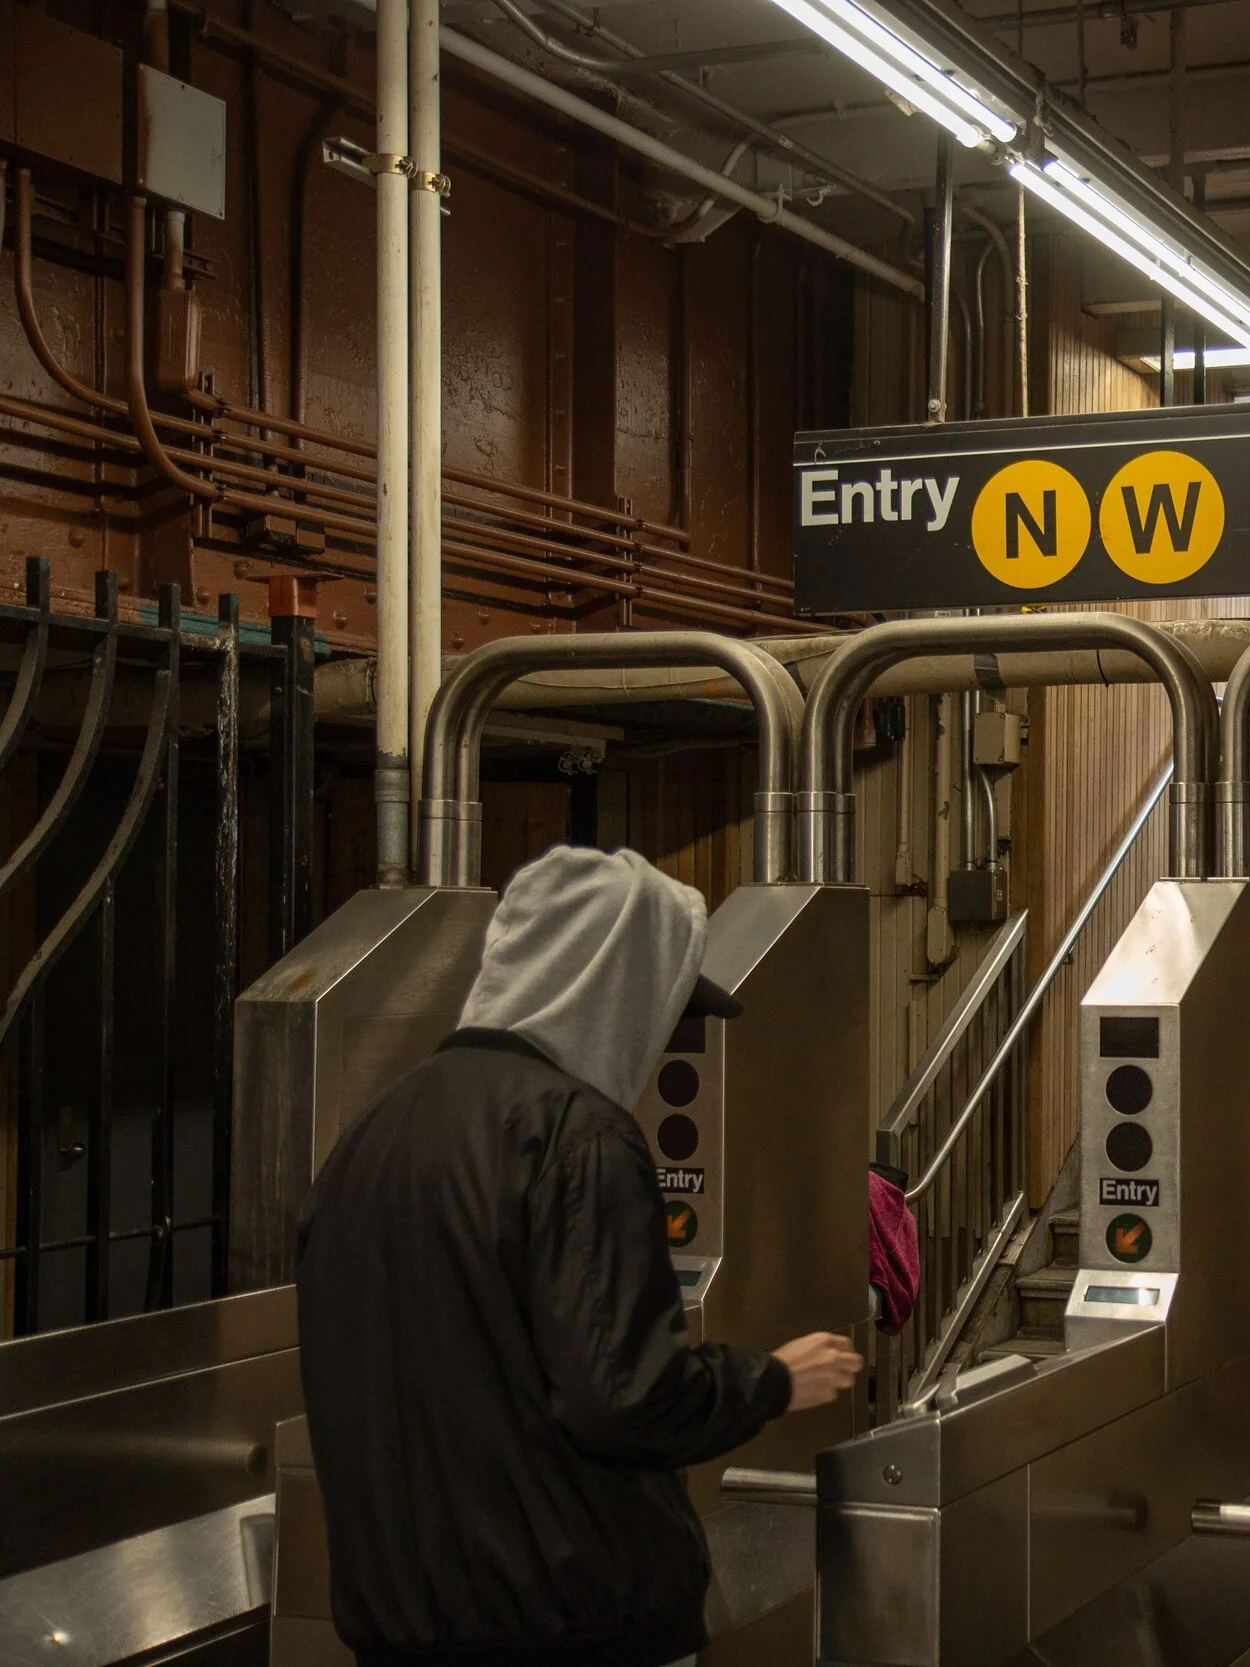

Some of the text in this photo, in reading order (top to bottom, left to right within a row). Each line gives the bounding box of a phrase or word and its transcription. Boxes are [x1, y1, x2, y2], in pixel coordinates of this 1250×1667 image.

[800, 469, 1202, 560] Entry N W
[656, 1168, 704, 1193] Entry
[1102, 1180, 1158, 1205] Entry
